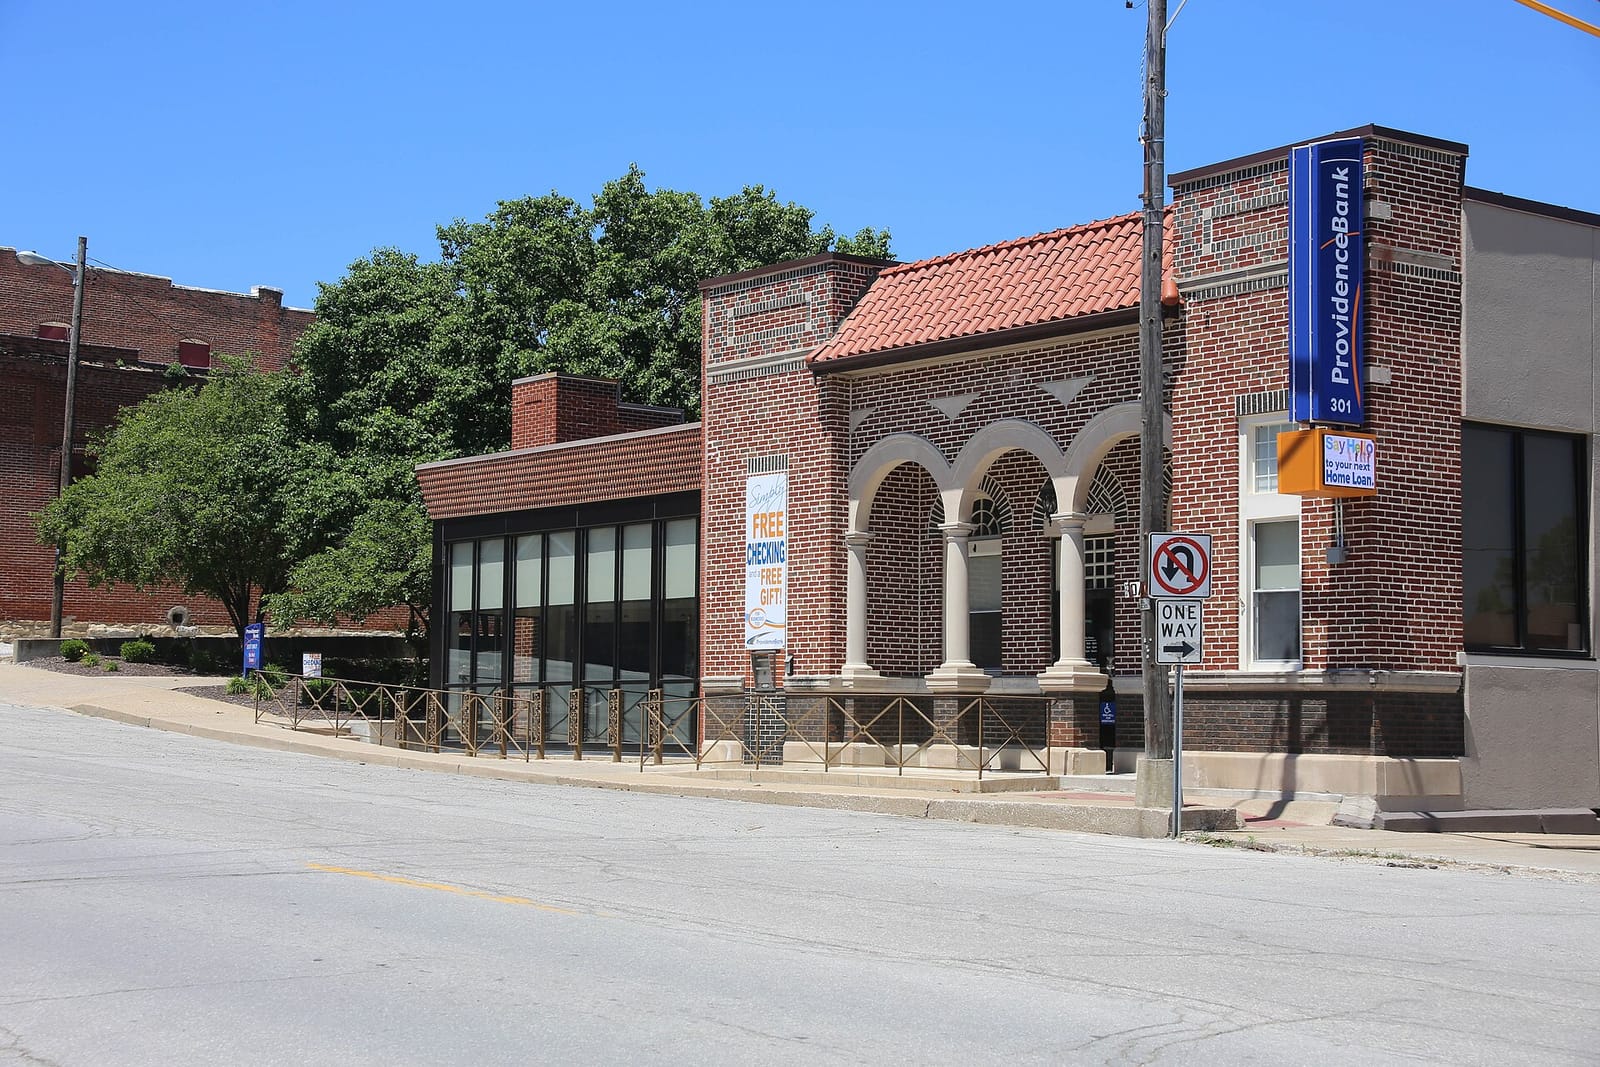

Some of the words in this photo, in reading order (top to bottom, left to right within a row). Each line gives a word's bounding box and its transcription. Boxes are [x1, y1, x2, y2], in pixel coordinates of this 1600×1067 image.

[1331, 166, 1349, 385] ProvidenceBank
[1330, 398, 1351, 414] 301
[1326, 437, 1346, 454] Say
[1347, 439, 1374, 455] Hello
[1326, 459, 1333, 468] to
[1335, 461, 1352, 471] your
[1353, 463, 1370, 472] next
[1326, 470, 1350, 484] Home
[1352, 472, 1374, 487] Loan.
[749, 476, 786, 512] Simply
[753, 511, 784, 539] FREE
[746, 541, 785, 566] CHECKING
[760, 567, 782, 586] FREE
[760, 587, 782, 606] GIFT!
[1162, 605, 1197, 620] ONE
[1161, 623, 1197, 638] WAY
